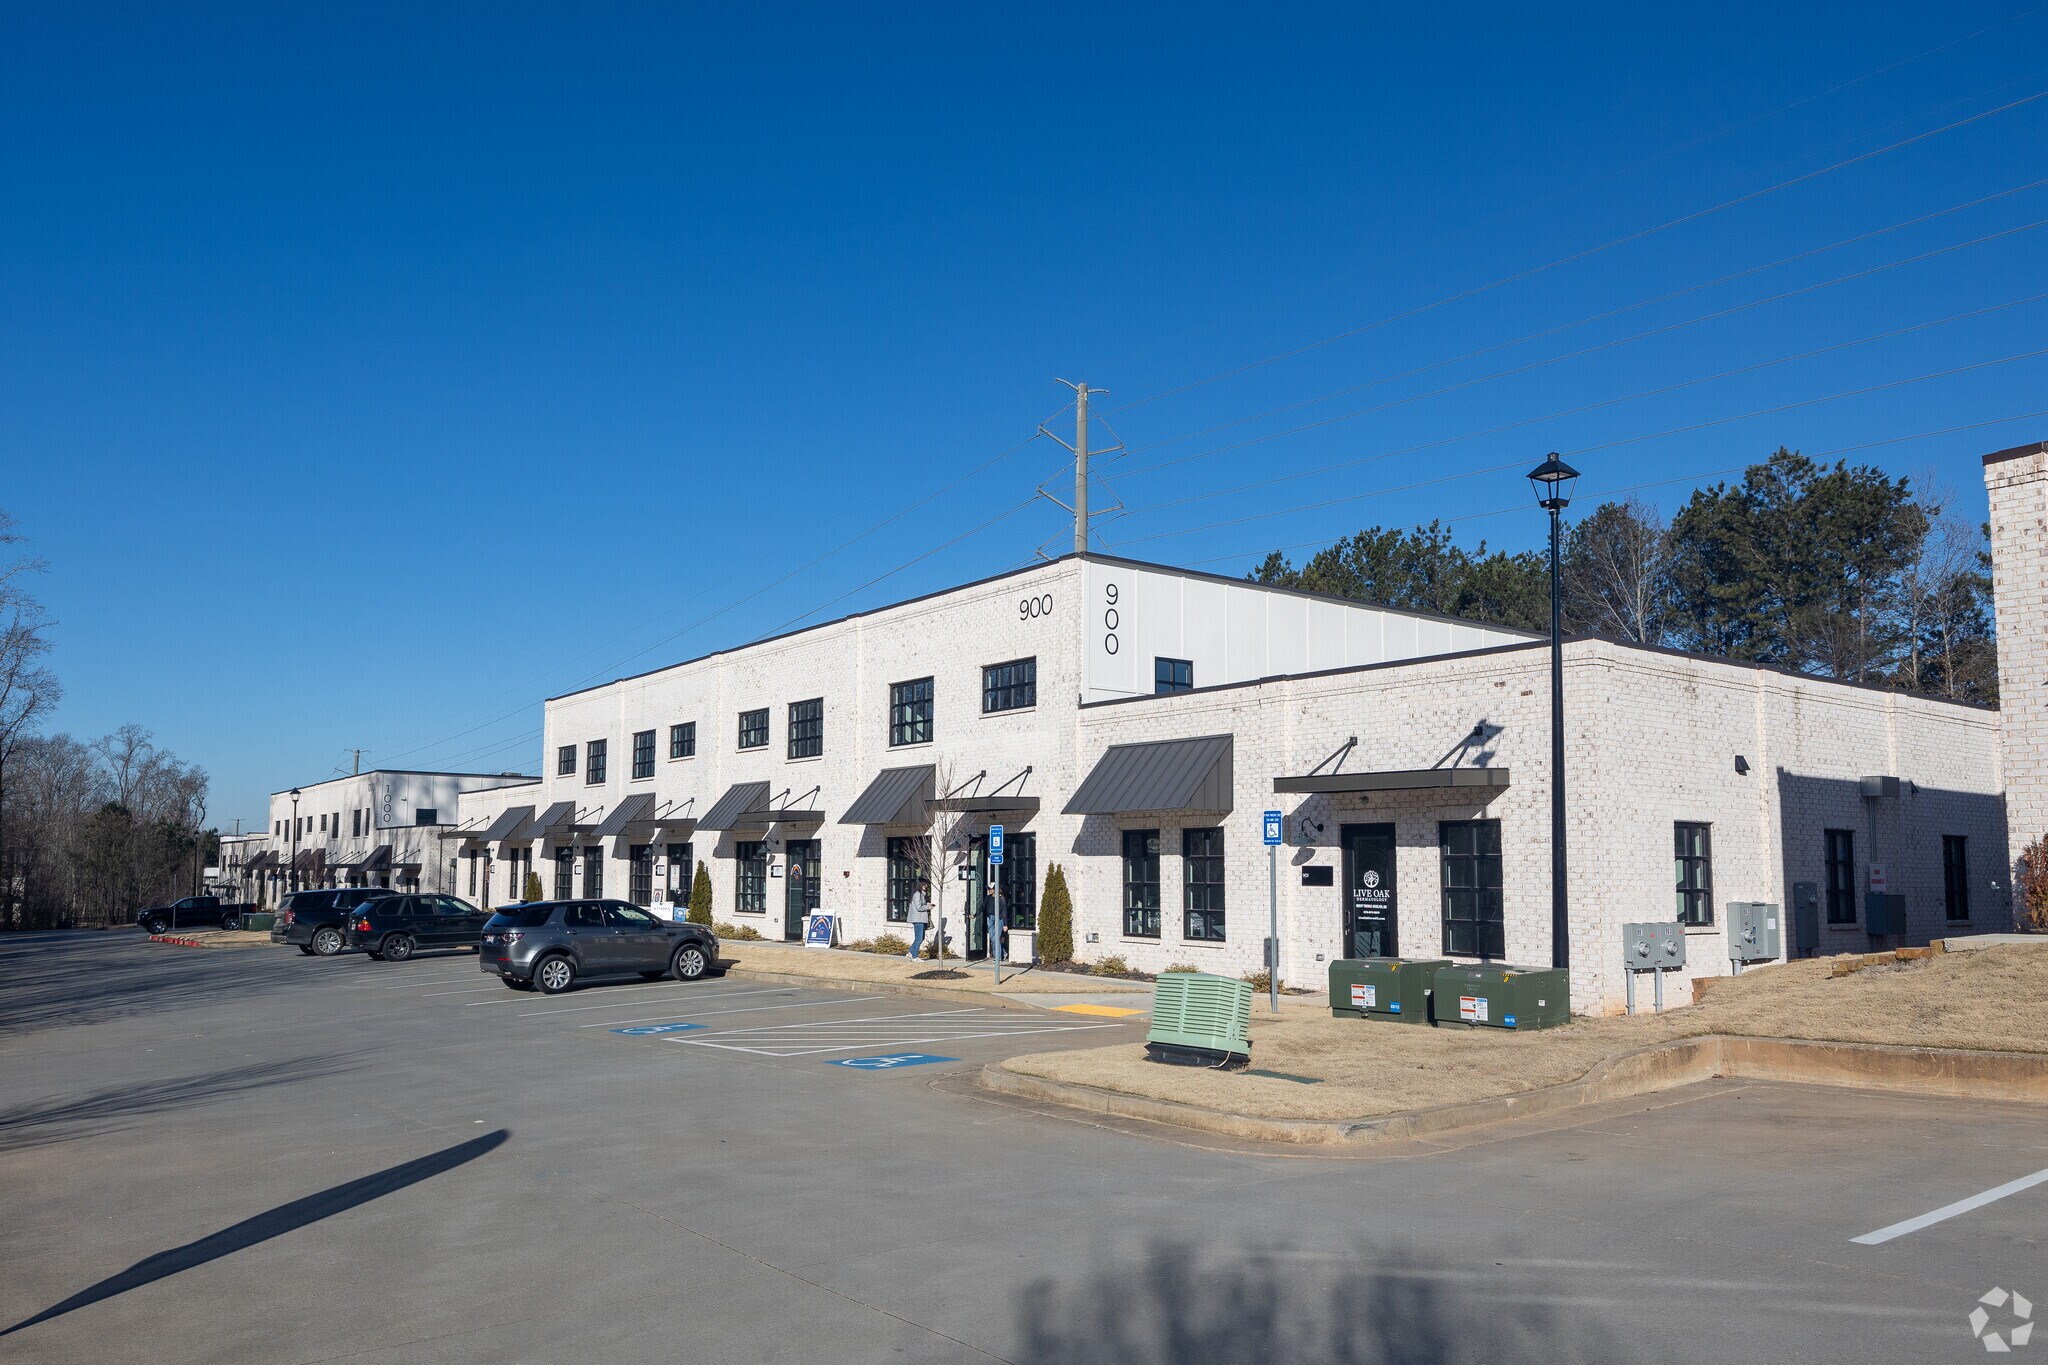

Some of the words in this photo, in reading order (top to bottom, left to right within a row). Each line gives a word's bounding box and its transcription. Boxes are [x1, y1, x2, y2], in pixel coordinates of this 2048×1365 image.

[1019, 594, 1053, 621] 900
[1105, 583, 1119, 655] 900
[383, 784, 392, 823] 1000
[1353, 889, 1372, 898] LIVE
[1373, 889, 1390, 898] OAK
